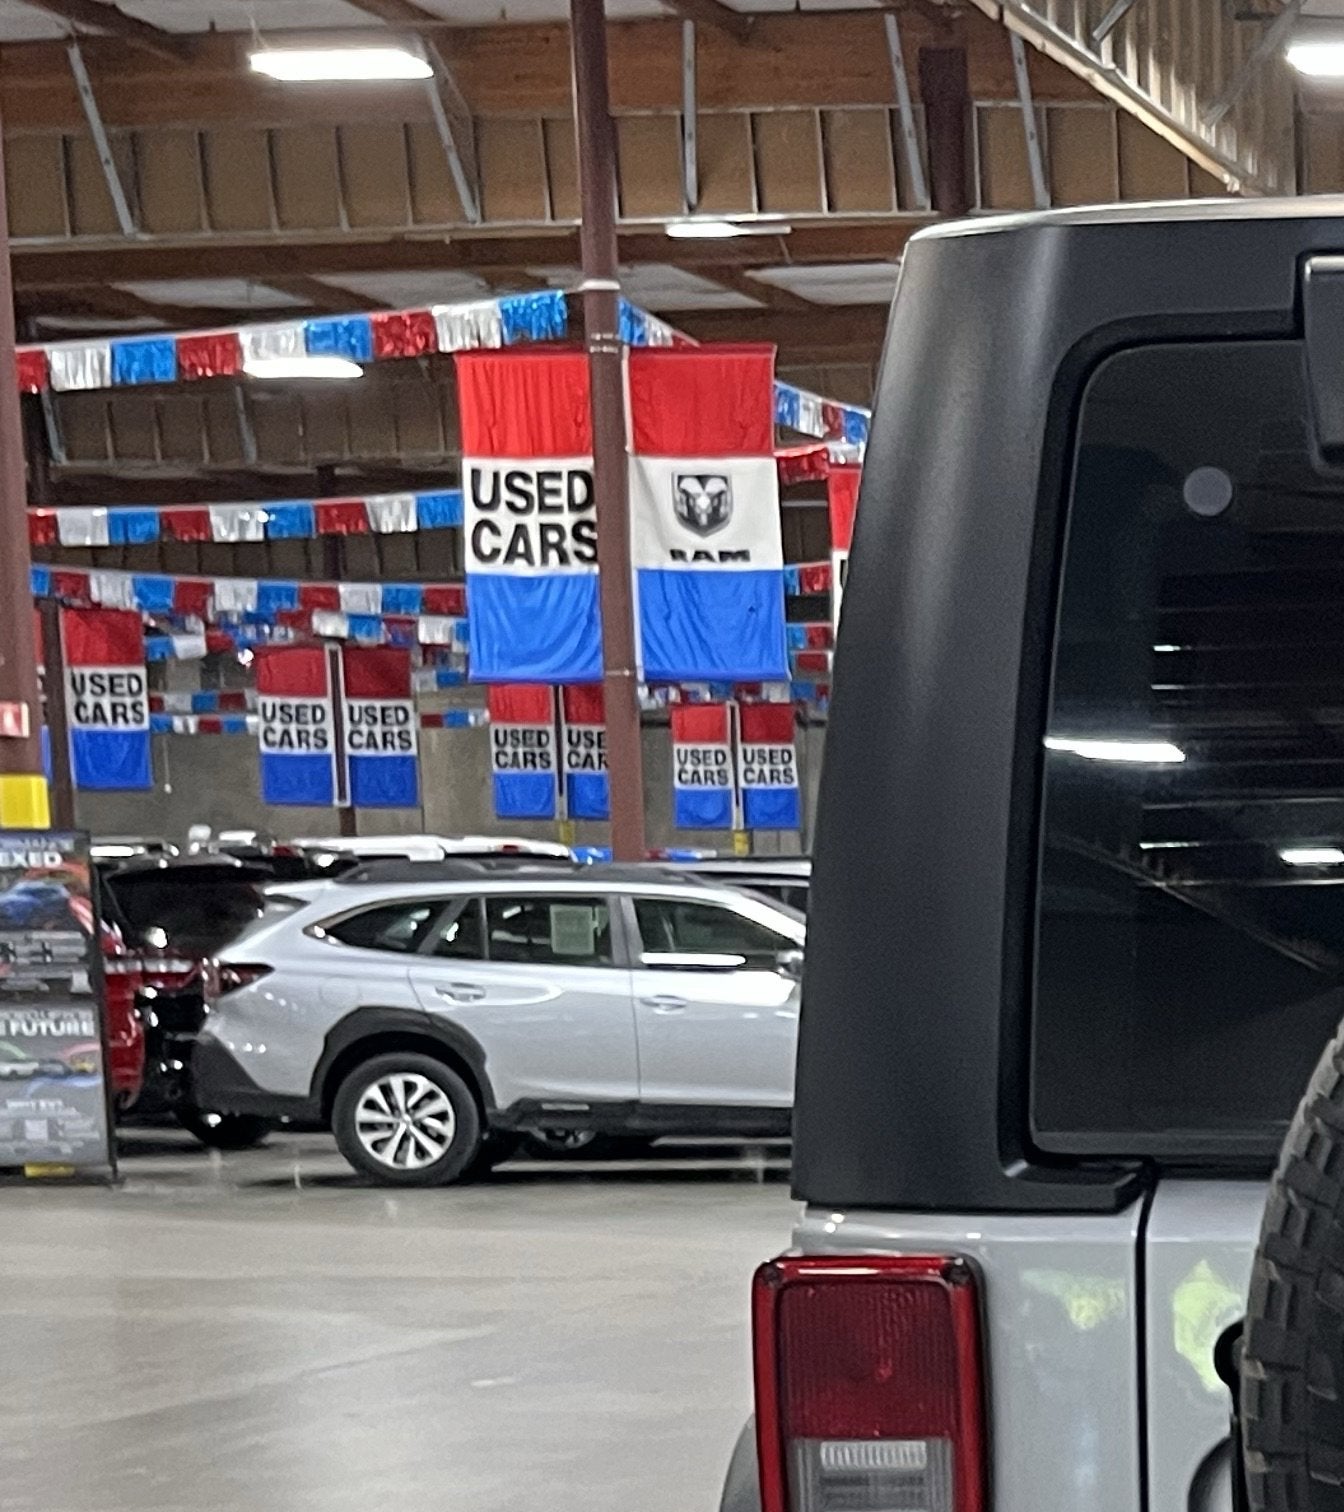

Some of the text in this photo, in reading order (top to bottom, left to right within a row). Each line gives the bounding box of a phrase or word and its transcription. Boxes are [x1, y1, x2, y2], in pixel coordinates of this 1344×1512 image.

[470, 469, 595, 514] USED
[471, 519, 598, 566] CARS
[669, 548, 751, 563] RAM
[71, 671, 142, 697] USED
[74, 700, 145, 726] CARS
[262, 702, 326, 725] USED
[348, 704, 410, 726] USED
[263, 726, 328, 749] CARS
[348, 729, 412, 750] CARS
[494, 729, 550, 748] USED
[567, 729, 606, 748] USE
[494, 751, 551, 769] CARS
[567, 751, 609, 770] CAR
[676, 750, 727, 766] USED
[743, 749, 792, 765] USED
[677, 768, 729, 786] CARS
[743, 767, 794, 785] CARS
